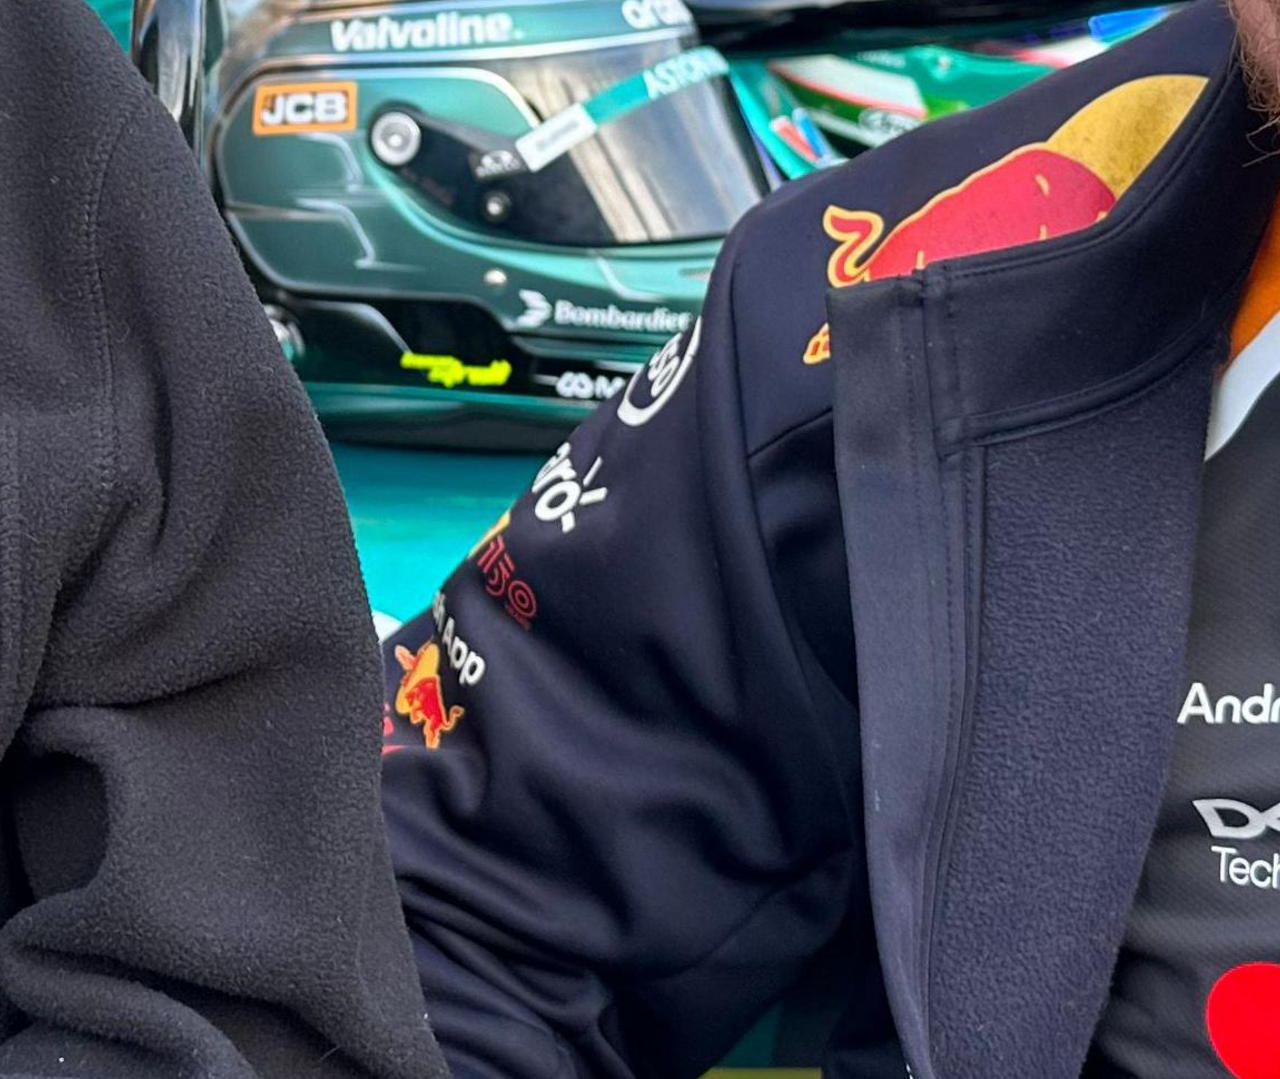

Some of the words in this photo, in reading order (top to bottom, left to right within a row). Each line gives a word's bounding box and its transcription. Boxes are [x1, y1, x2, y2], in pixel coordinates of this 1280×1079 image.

[260, 91, 347, 126] JCB
[554, 299, 692, 332] Bombardier
[442, 616, 486, 687] App
